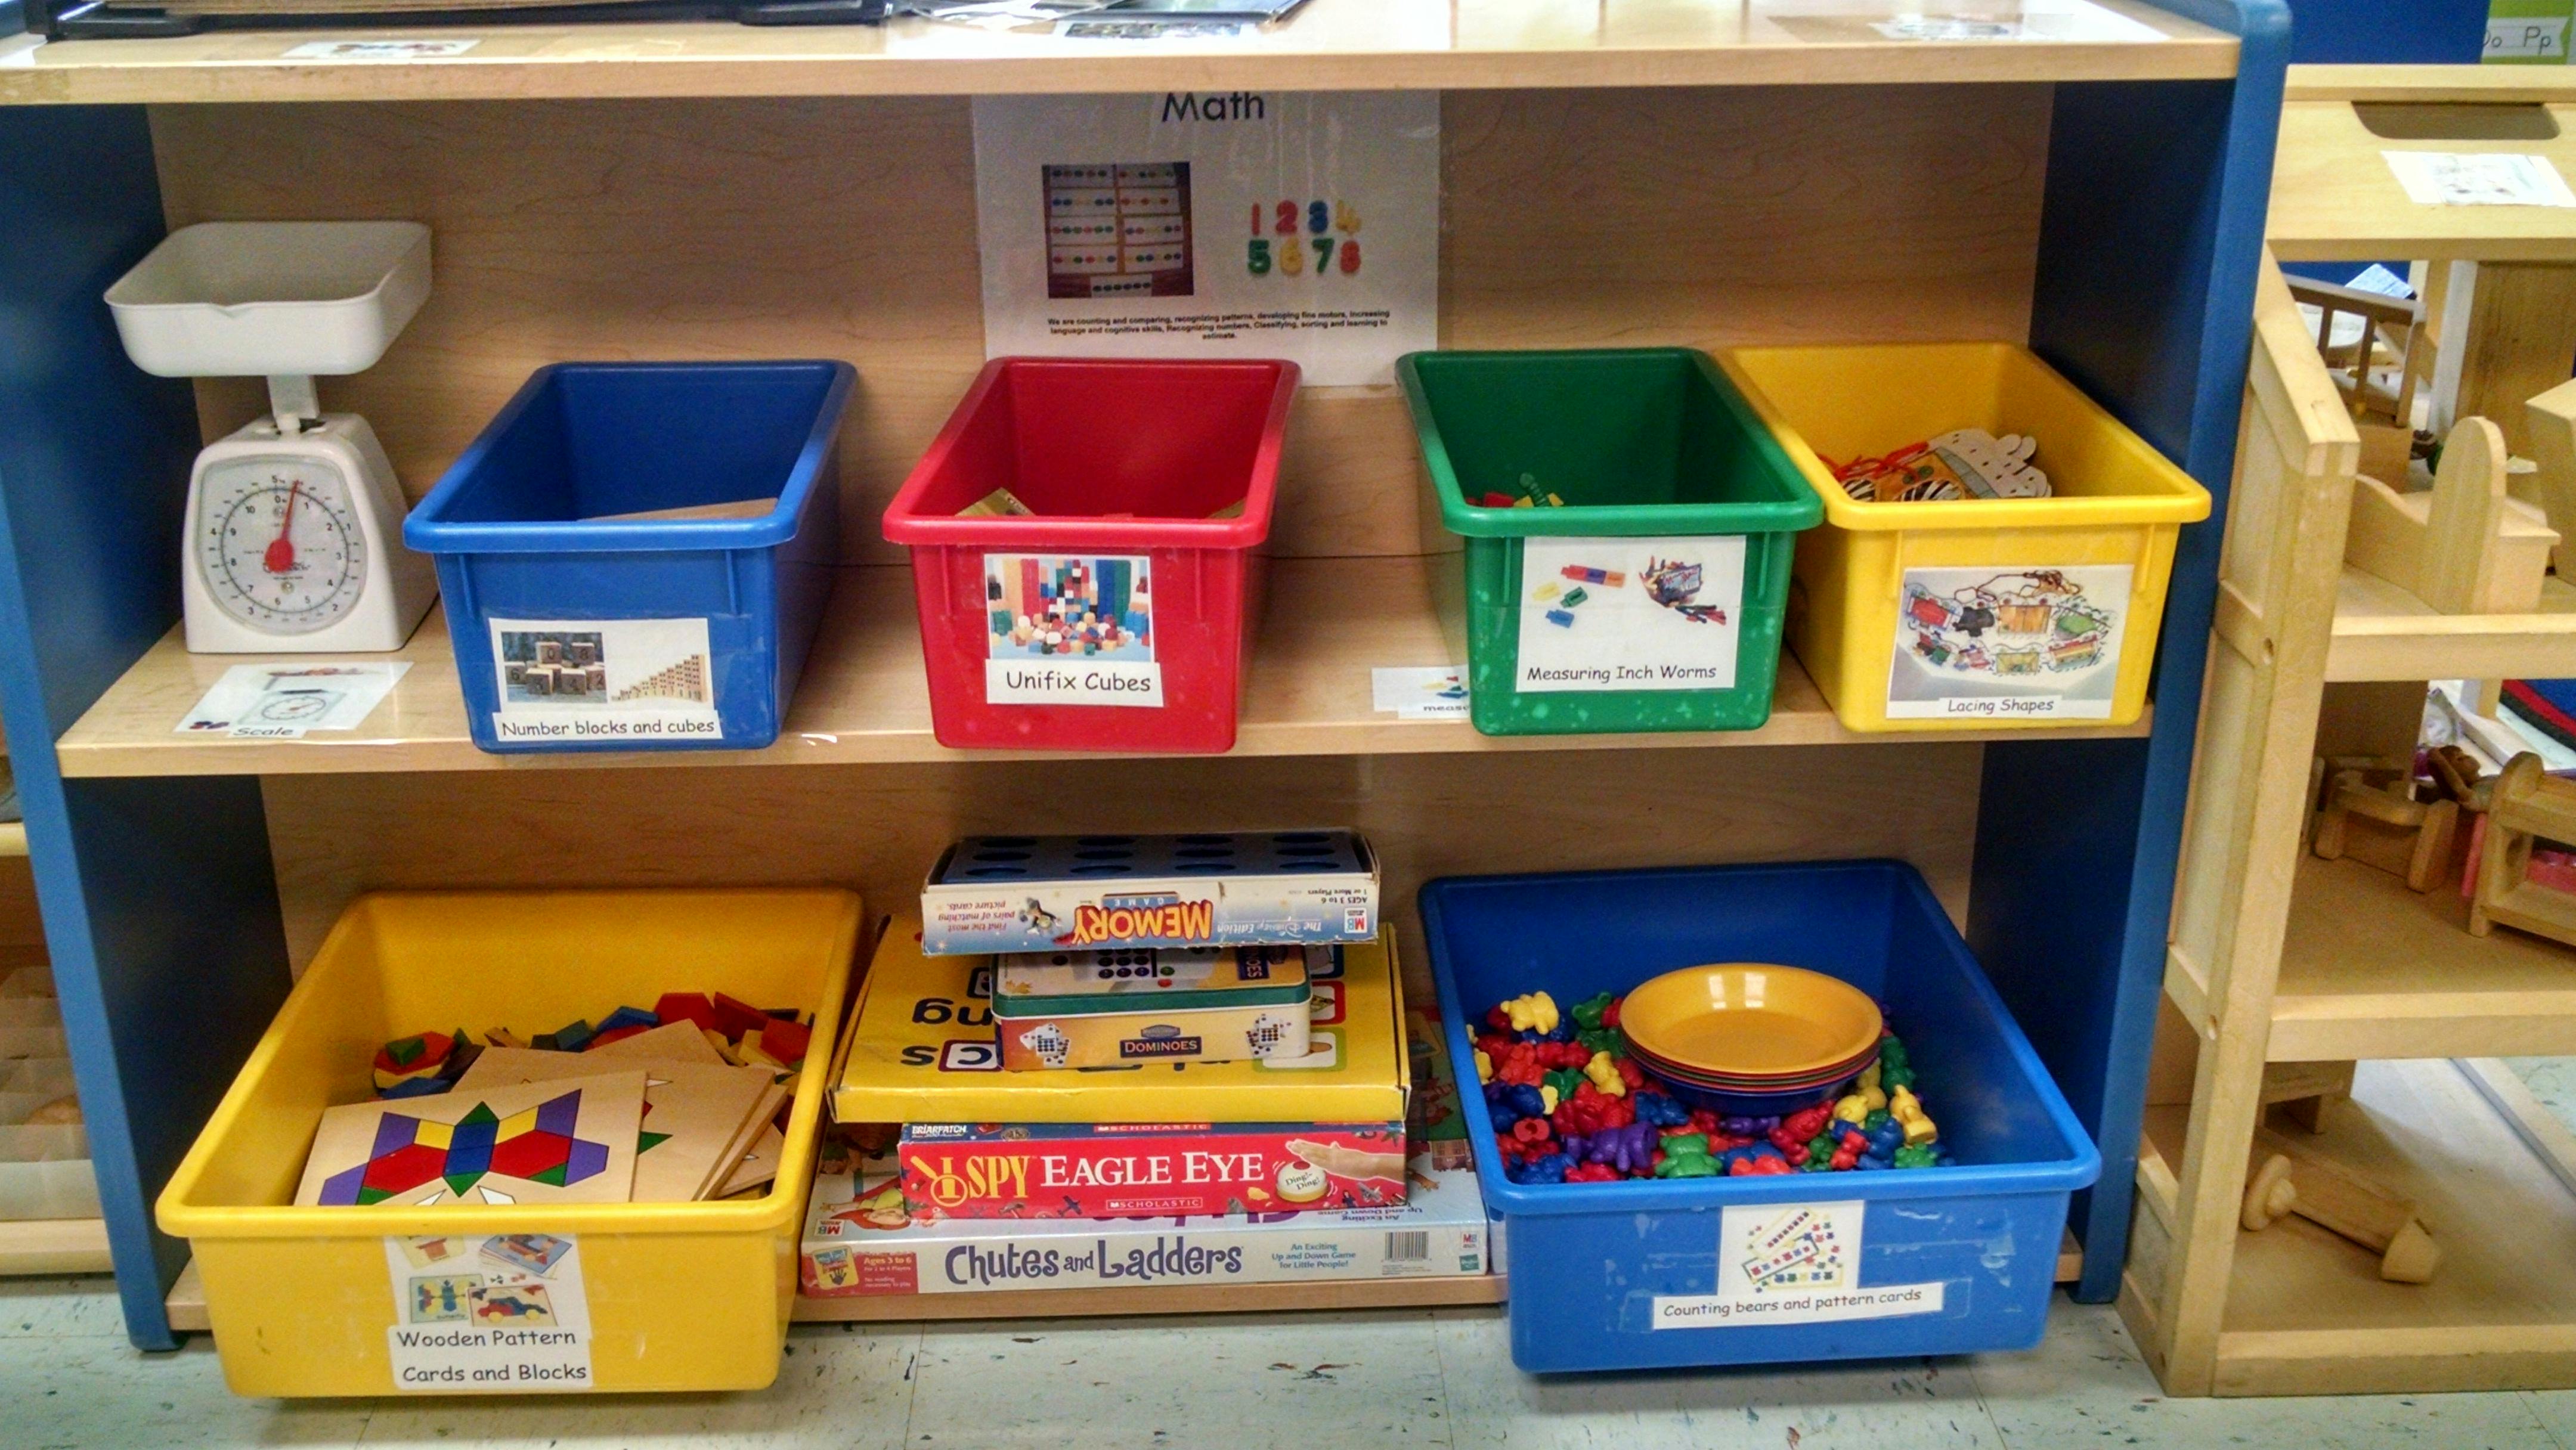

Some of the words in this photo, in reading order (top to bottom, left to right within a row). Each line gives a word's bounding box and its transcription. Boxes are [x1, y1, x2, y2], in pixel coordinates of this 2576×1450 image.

[2524, 26, 2552, 54] Pp
[1162, 92, 1264, 122] Math
[1252, 203, 1261, 237] 1
[1276, 200, 1299, 235] 2
[1309, 200, 1329, 234] 3
[1336, 200, 1361, 236] 4
[1248, 240, 1271, 275] 5
[1280, 237, 1303, 276] 6
[1312, 238, 1335, 273] 7
[1340, 240, 1361, 274] 8
[1076, 317, 1110, 326] counting
[1129, 316, 1172, 326] comparing,
[1175, 315, 1219, 323] recognizing
[1258, 312, 1300, 320] developing
[1050, 327, 1086, 336] language
[1105, 326, 1140, 334] cognitive
[1166, 324, 1214, 333] Recognizing
[1346, 320, 1378, 328] learning
[1006, 670, 1077, 691] Unifix
[1085, 672, 1151, 692] Cubes
[1527, 667, 1611, 684] Measuring
[1615, 665, 1654, 680] Inch
[1659, 665, 1717, 680] Worms
[1948, 699, 1995, 714] Lacing
[2000, 698, 2055, 713] Shapes
[233, 727, 293, 736] Scale
[501, 721, 569, 736] Number
[575, 720, 628, 735] blocks
[633, 718, 661, 733] and
[667, 718, 715, 733] cubes
[974, 900, 1006, 910] picture
[1114, 897, 1165, 907] GAME
[938, 913, 979, 922] matching
[993, 910, 1015, 920] pairs
[948, 924, 970, 932] most
[1072, 901, 1213, 944] MEMORY
[1217, 924, 1255, 934] Edition
[1303, 922, 1322, 932] The
[1346, 918, 1365, 930] MB
[1125, 1040, 1198, 1054] DOMINOES
[1040, 1155, 1172, 1187] EAGLE
[1181, 1151, 1264, 1183] EYE
[965, 1155, 1031, 1198] SPY
[1296, 1176, 1320, 1191] Ding!
[1119, 1200, 1200, 1209] SCHOLASTIC
[818, 1225, 841, 1235] MB
[1463, 1234, 1478, 1243] MB
[1305, 1243, 1338, 1251] Exciting
[864, 1257, 886, 1266] Ages
[945, 1243, 1060, 1286] Chutes
[1063, 1250, 1094, 1272] and
[1097, 1235, 1243, 1281] Ladders
[1271, 1253, 1284, 1262] Up
[1317, 1260, 1349, 1269] People!
[1664, 1305, 1730, 1317] Counting
[1735, 1300, 1778, 1313] bears
[1784, 1297, 1810, 1310] and
[1815, 1295, 1875, 1311] pattern
[1878, 1290, 1922, 1304] cards
[397, 1330, 486, 1347] Wooden
[493, 1330, 577, 1346] Pattern
[402, 1365, 465, 1383] Cards
[472, 1365, 510, 1381] and
[518, 1364, 587, 1380] Blocks
